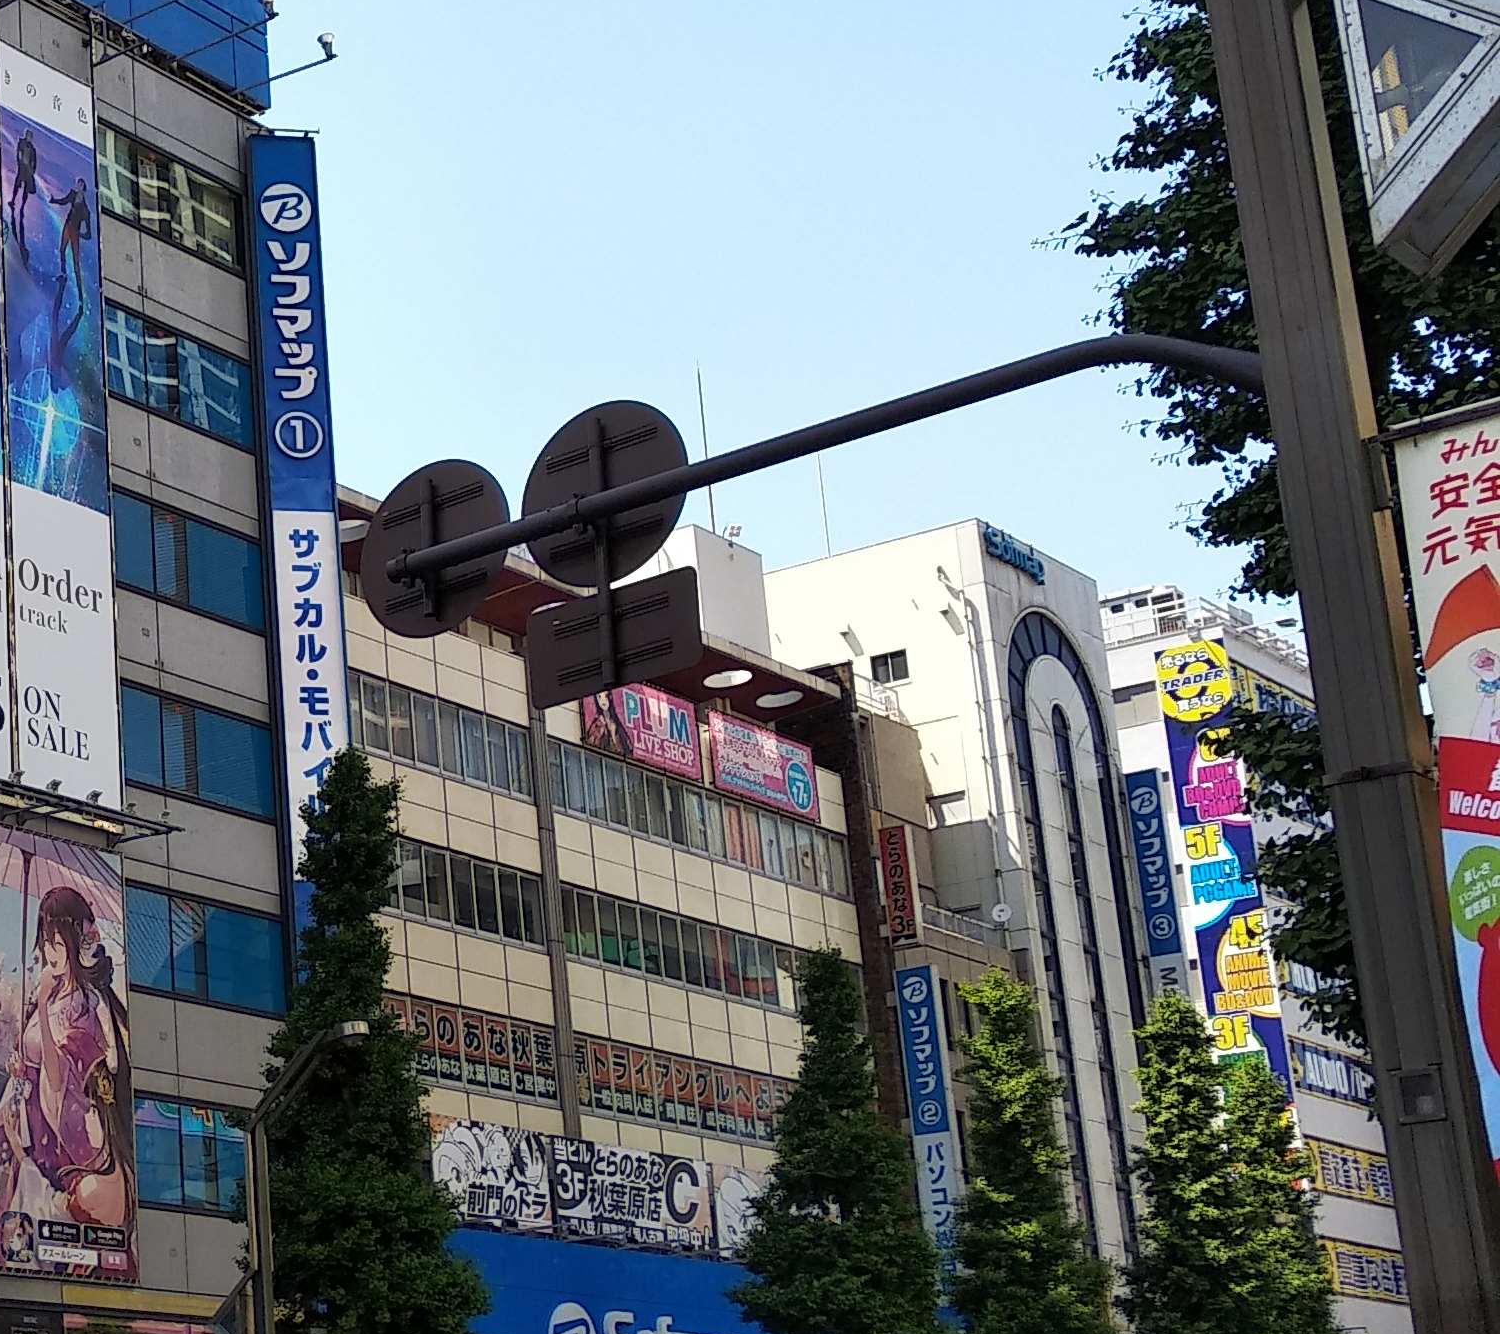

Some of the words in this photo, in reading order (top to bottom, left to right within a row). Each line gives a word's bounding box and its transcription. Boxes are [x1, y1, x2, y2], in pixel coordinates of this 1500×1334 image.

[267, 240, 318, 400] ソフマップ
[19, 558, 103, 615] Order
[1161, 667, 1225, 691] TRADER
[24, 685, 62, 720] ON
[622, 688, 693, 747] PLUM
[27, 717, 90, 761] SALE
[632, 730, 662, 756] LIVE
[664, 741, 694, 766] SHOP
[1184, 826, 1222, 859] 5F
[885, 830, 912, 912] とらのあな
[1135, 820, 1168, 908] ソフマップ
[1191, 857, 1242, 884] ADULT
[1226, 951, 1268, 973] ANIME
[1226, 968, 1271, 991] MOVIE
[1213, 1015, 1251, 1050] 3F
[908, 1007, 939, 1098] ソフマップ
[553, 1138, 591, 1164] 当ビル
[593, 1148, 663, 1187] とらのあな
[555, 1163, 587, 1201] 3F
[588, 1178, 662, 1222] 秋葉原店
[665, 1162, 700, 1223] C
